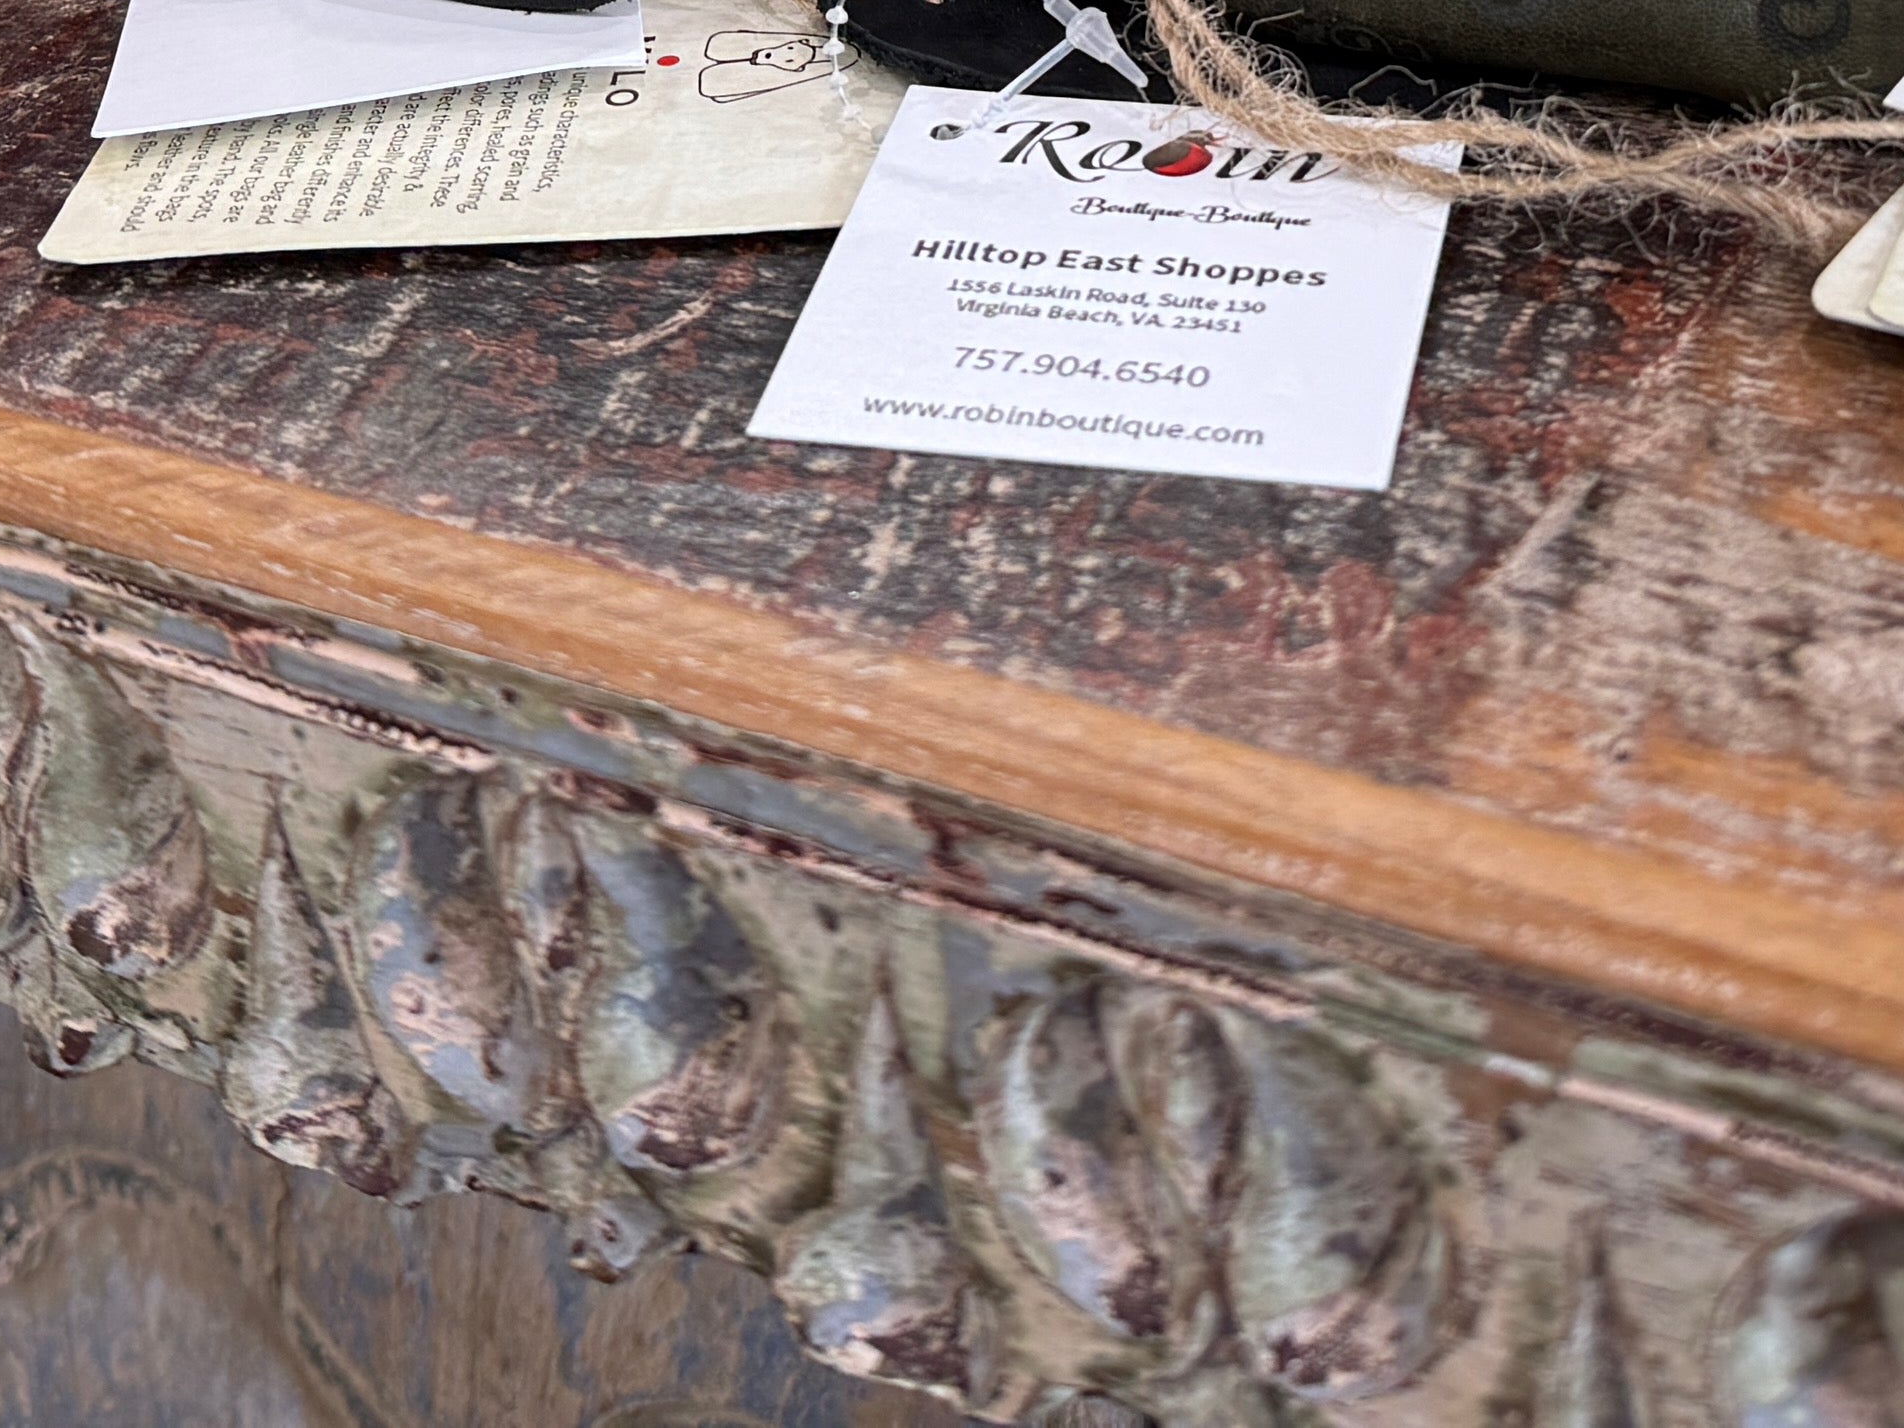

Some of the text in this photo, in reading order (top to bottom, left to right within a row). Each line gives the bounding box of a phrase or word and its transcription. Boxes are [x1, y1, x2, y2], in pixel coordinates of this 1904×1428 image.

[402, 103, 420, 120] are
[426, 115, 451, 132] the
[525, 108, 544, 132] such
[384, 123, 411, 164] actually
[480, 127, 510, 162] healed
[519, 135, 534, 146] as
[532, 72, 588, 193] unique characteristics,
[257, 140, 277, 154] All
[315, 126, 349, 166] finishes
[351, 138, 370, 158] and
[186, 162, 206, 173] in
[249, 156, 269, 173] our
[279, 141, 312, 184] leather
[509, 149, 530, 178] grain
[175, 174, 199, 193] the
[430, 174, 460, 207] These
[500, 180, 520, 201] and
[221, 205, 242, 223] are
[254, 204, 277, 225] and
[322, 208, 343, 223] its
[911, 238, 1329, 289] Hilltop East Shoppes
[945, 277, 1267, 315] 1556 Laskin Road, Suite 130
[956, 298, 1042, 320] Virginia
[1046, 303, 1125, 327] Beach,
[1172, 316, 1243, 335] 23451
[954, 345, 1211, 390] 757.904.6540
[862, 393, 1266, 447] www.robinboutique.com
